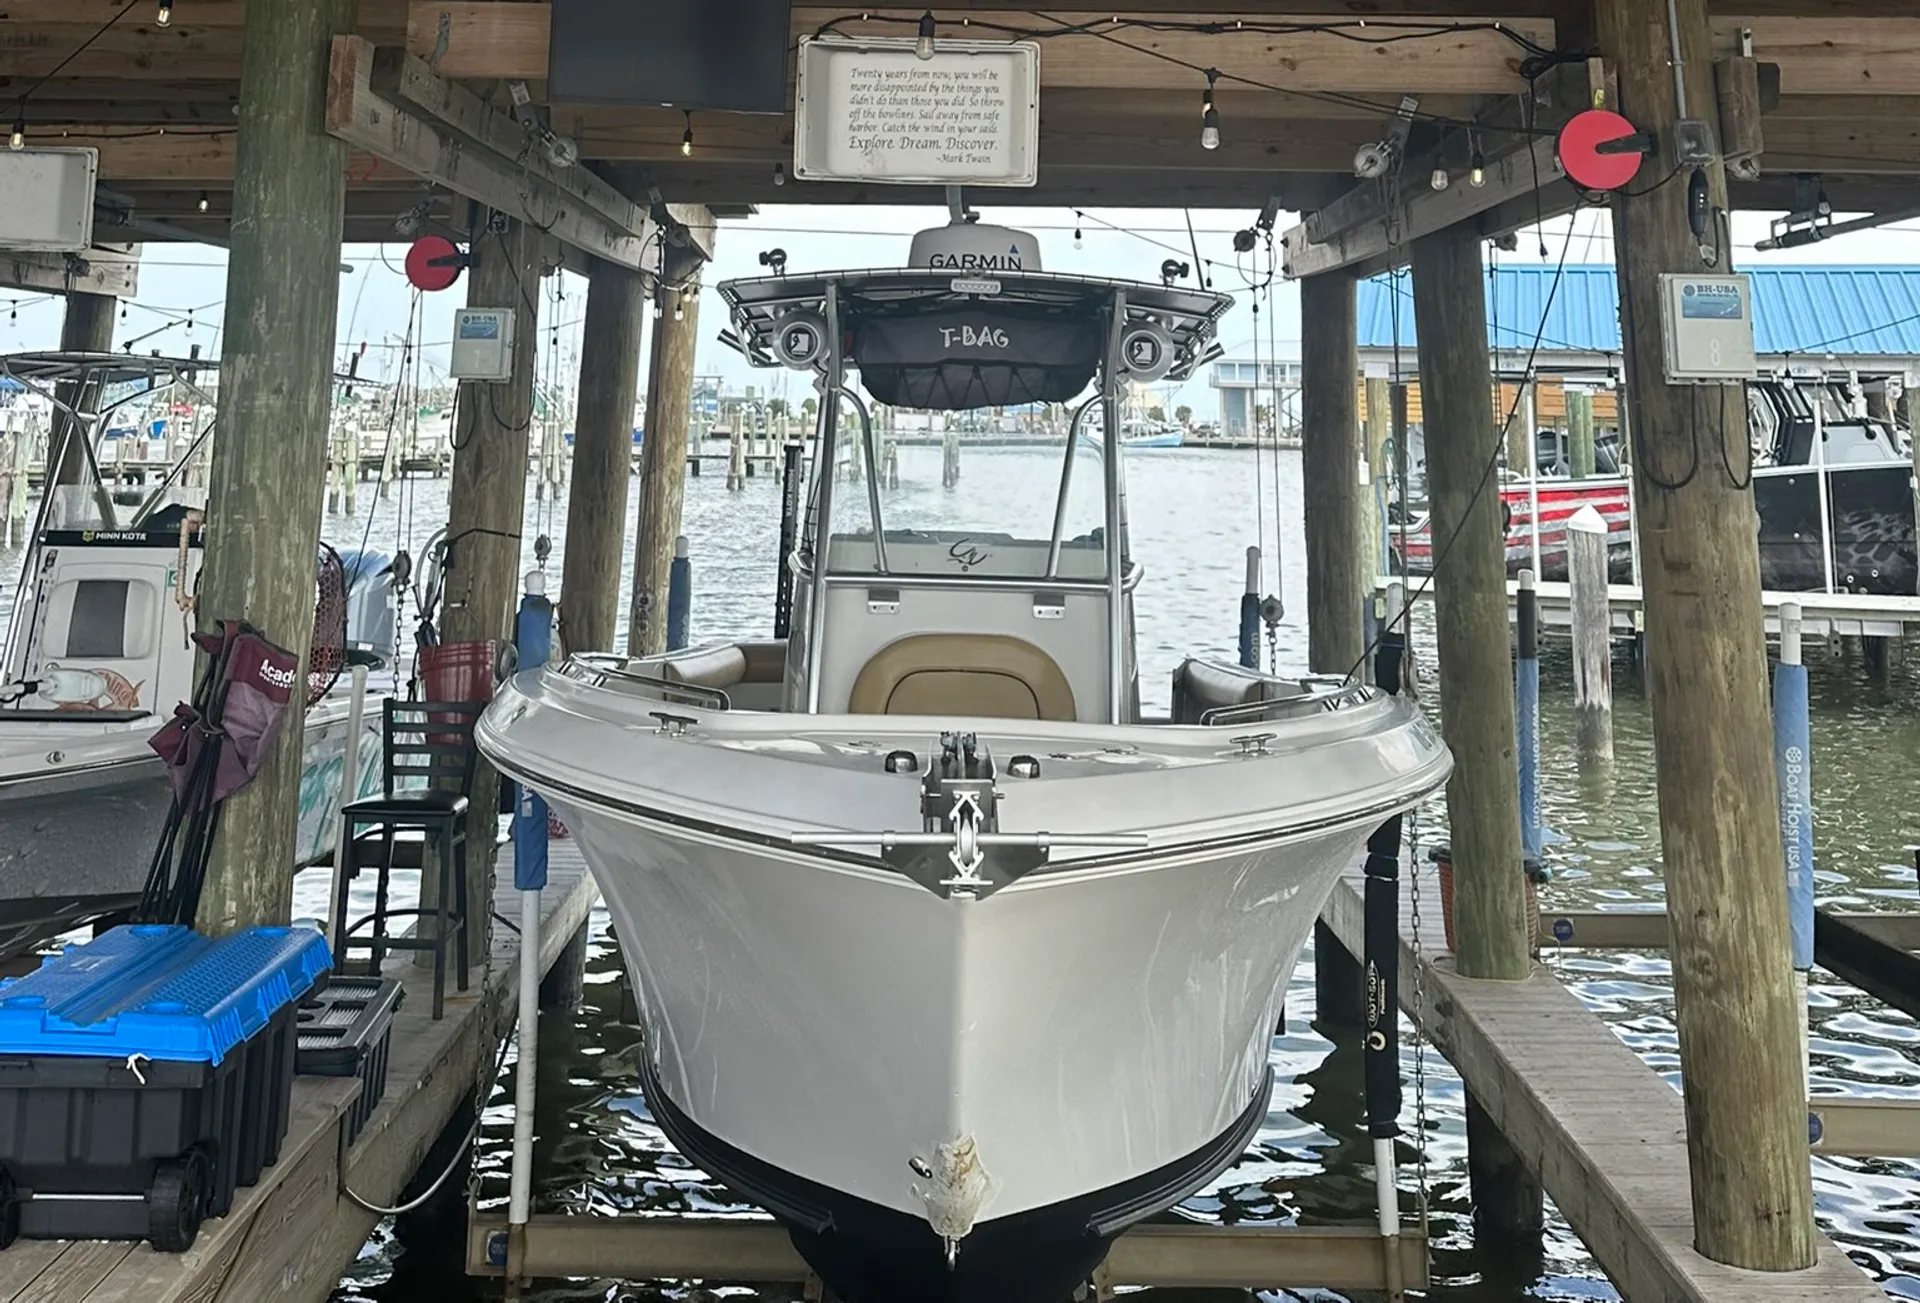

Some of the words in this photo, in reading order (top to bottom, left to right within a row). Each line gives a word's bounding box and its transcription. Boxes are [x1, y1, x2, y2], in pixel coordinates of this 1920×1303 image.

[851, 68, 883, 82] Twenty
[884, 71, 908, 82] years
[908, 68, 930, 82] from
[953, 72, 970, 82] you
[971, 68, 989, 79] will
[988, 70, 998, 80] be
[850, 83, 872, 92] more
[873, 82, 929, 96] disappointed
[928, 81, 939, 96] by
[941, 83, 955, 93] the
[956, 83, 982, 96] things
[984, 85, 1000, 96] you
[849, 94, 874, 105] didn't
[876, 94, 887, 105] do
[888, 96, 909, 105] than
[910, 95, 932, 106] those
[933, 98, 949, 112] you
[968, 97, 979, 107] So
[980, 98, 1004, 107] throw
[848, 107, 862, 123] off
[863, 108, 876, 119] the
[918, 109, 933, 120] Sail
[935, 112, 959, 123] away
[959, 109, 981, 123] from
[983, 109, 1000, 124] safe
[881, 122, 906, 132] Catch
[908, 121, 920, 132] the
[923, 122, 946, 133] wind
[947, 124, 956, 133] in
[957, 125, 977, 138] your
[900, 136, 941, 149] Dream.
[945, 136, 998, 150] Discover.
[965, 153, 991, 163] Twain
[929, 253, 1021, 270] GARMIN
[939, 325, 1009, 348] T-BAG
[1711, 338, 1721, 366] 8
[785, 494, 793, 517] KOTA
[96, 532, 120, 540] MINN
[121, 532, 147, 540] KOTA
[1787, 845, 1801, 870] USA
